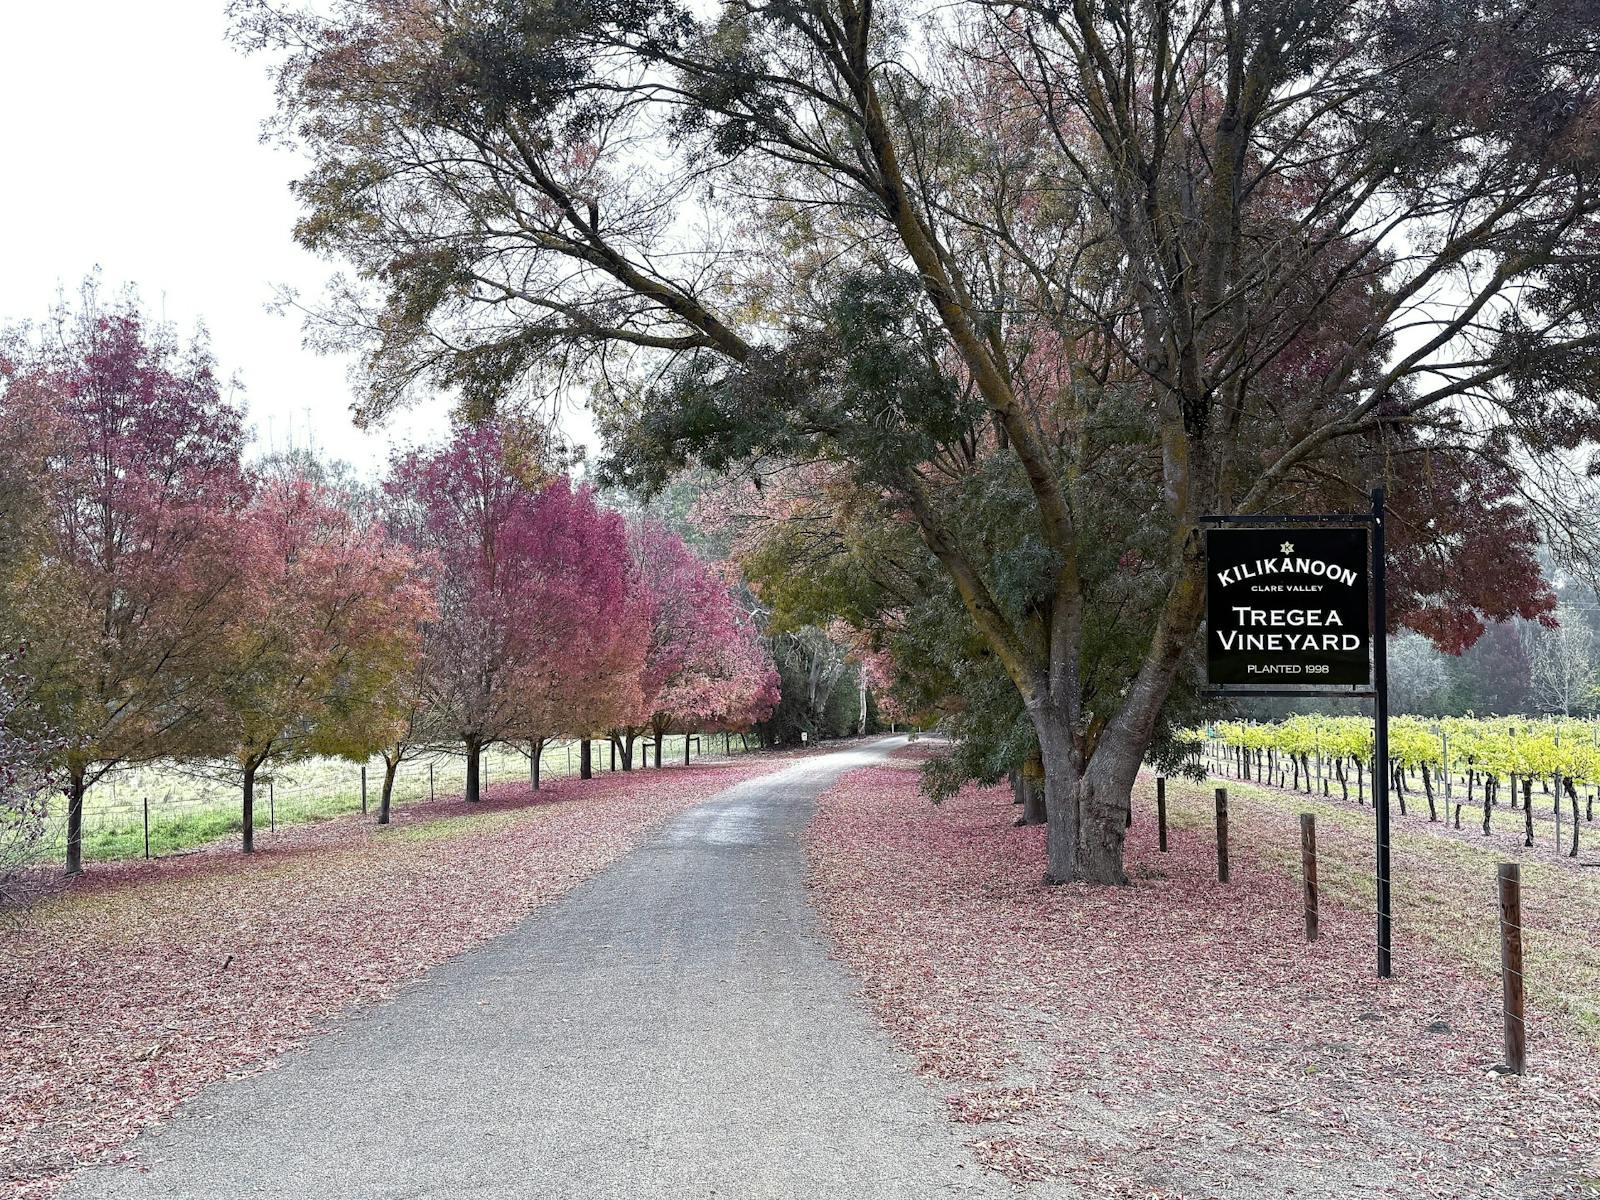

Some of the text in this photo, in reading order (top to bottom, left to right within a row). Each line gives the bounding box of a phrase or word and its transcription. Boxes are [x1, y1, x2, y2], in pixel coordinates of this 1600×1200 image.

[1216, 557, 1358, 587] KILIKANOON
[1231, 606, 1344, 627] TREGEA
[1216, 630, 1361, 651] VINEYARD
[1247, 664, 1330, 674] PLANTED 1998
